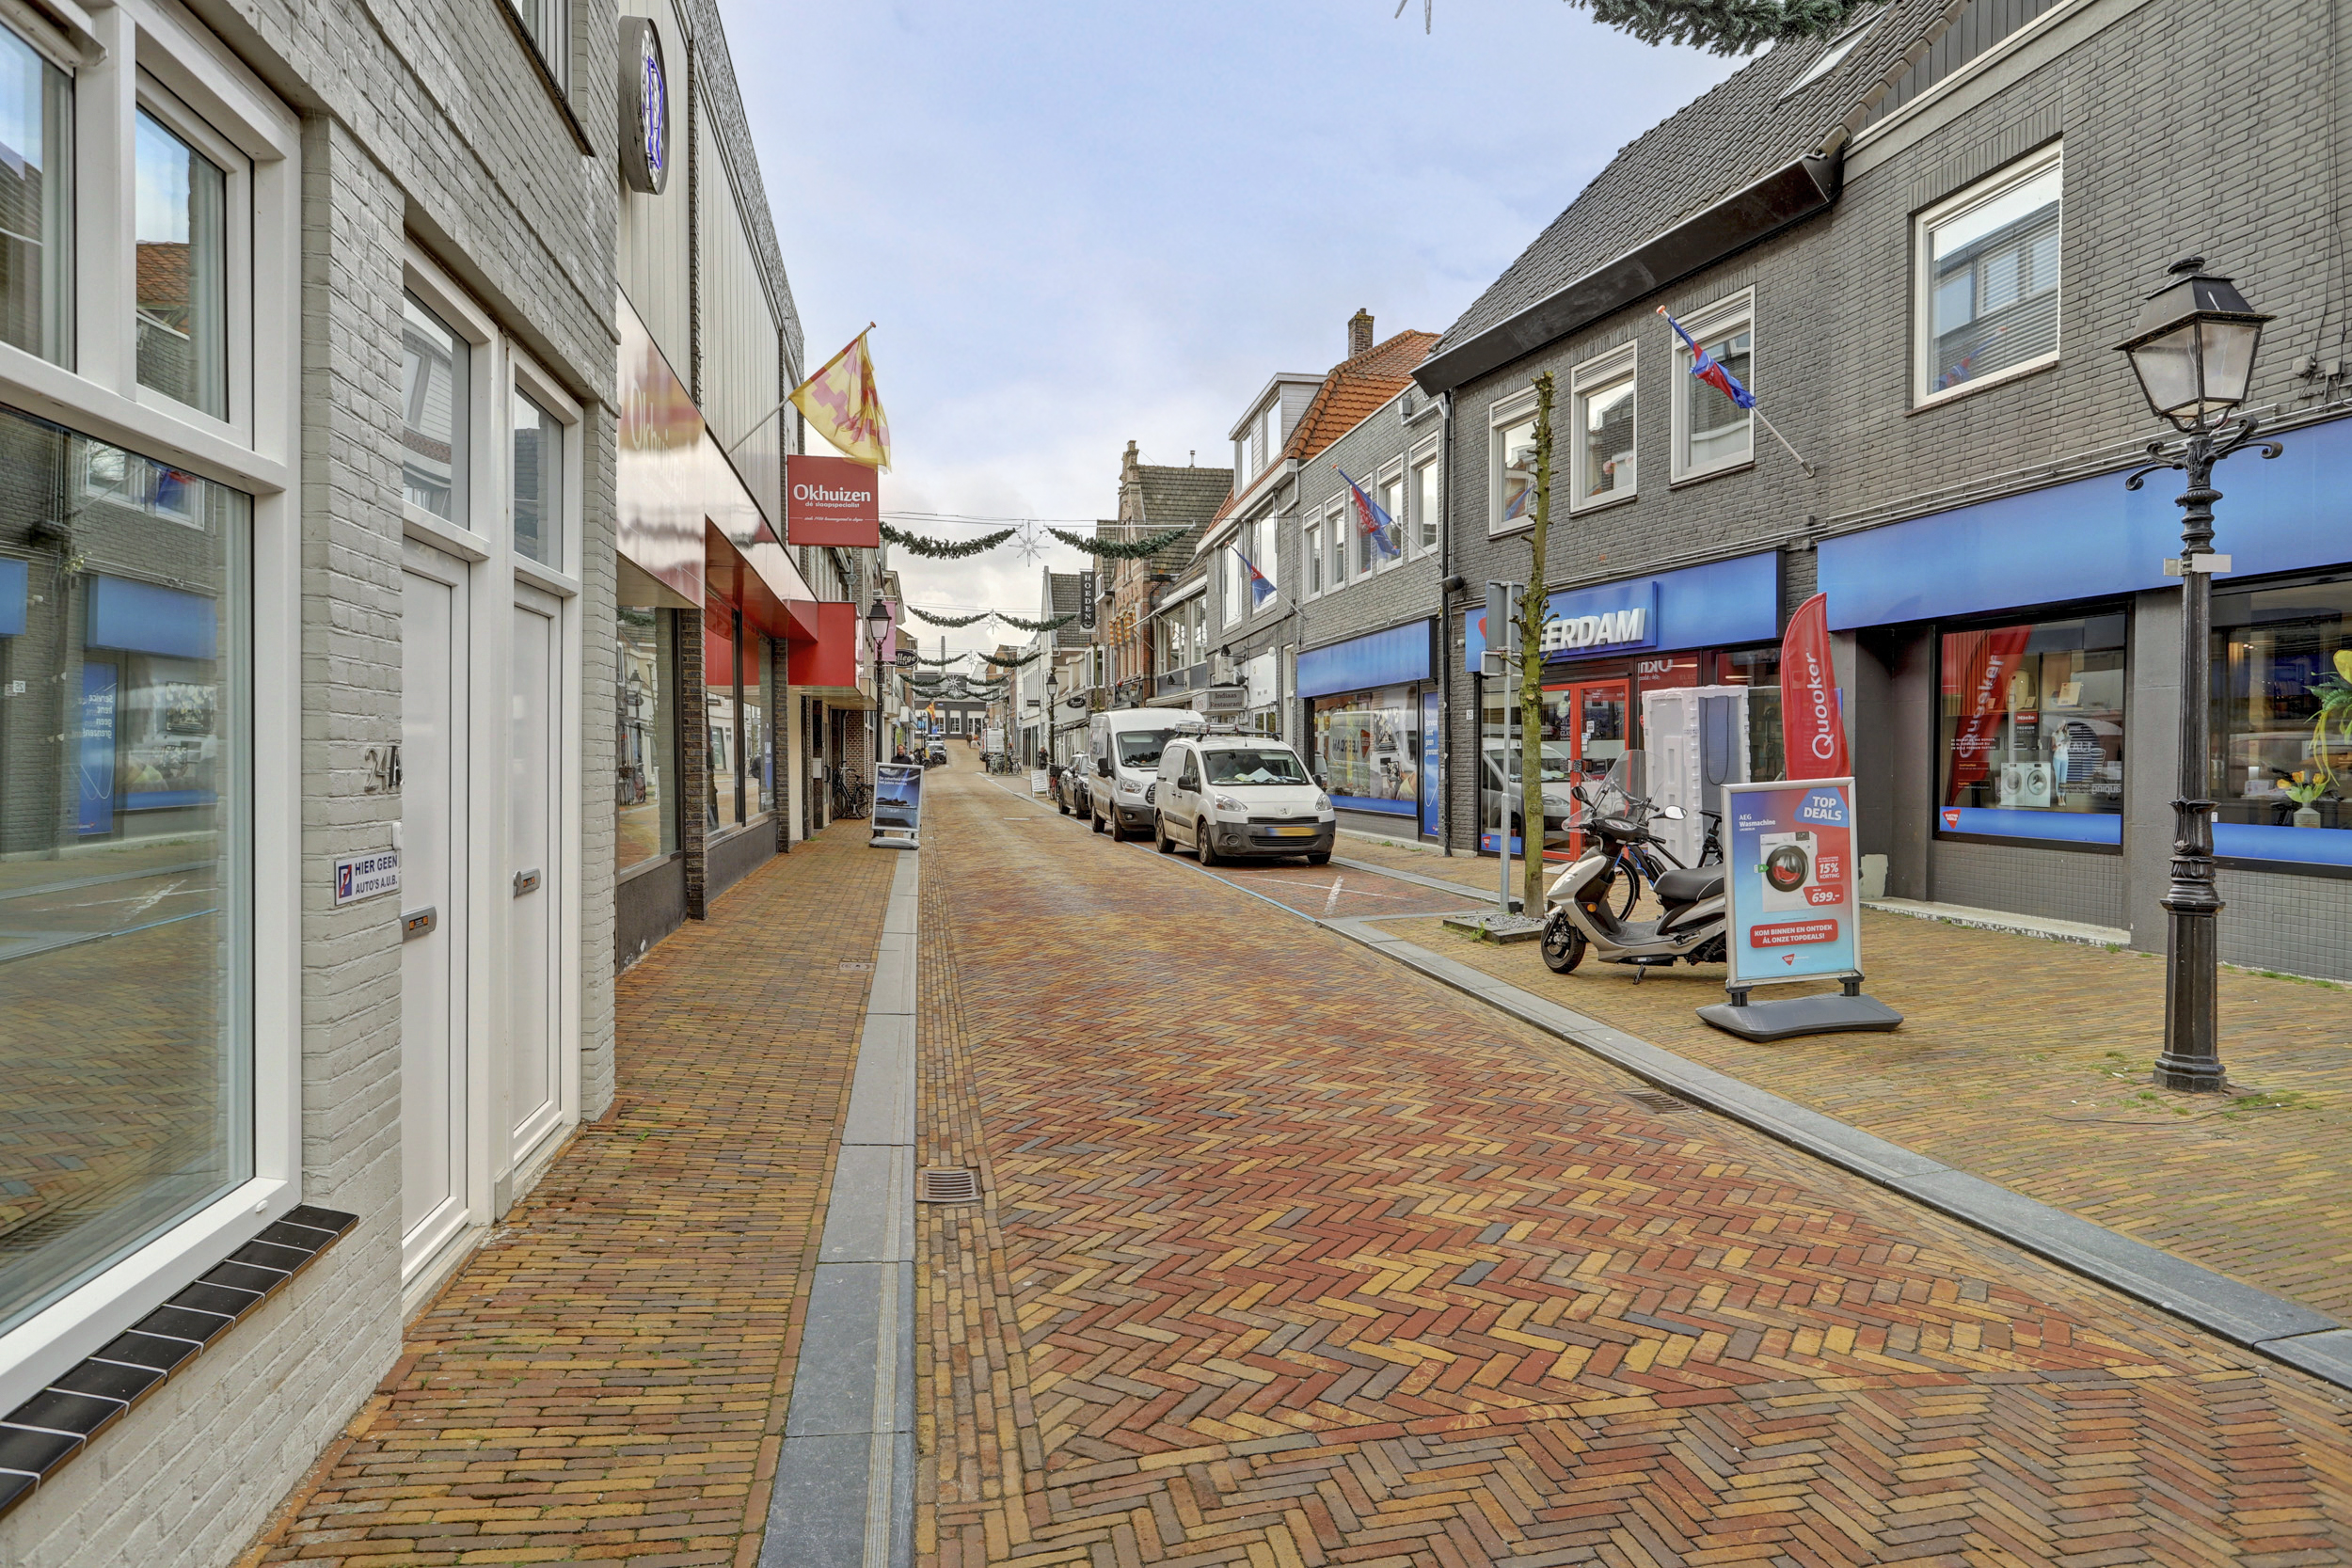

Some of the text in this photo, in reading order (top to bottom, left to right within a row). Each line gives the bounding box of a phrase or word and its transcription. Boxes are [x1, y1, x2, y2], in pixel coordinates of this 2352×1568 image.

[793, 483, 871, 502] Okhuizen
[1084, 574, 1092, 620] HOEDEN
[1807, 652, 1836, 760] Quooker
[1467, 710, 1473, 720] 25
[1812, 796, 1837, 808] TOP
[1804, 807, 1842, 821] DEALS
[1739, 819, 1776, 828] Wasmachine
[355, 855, 398, 877] HIER GEEN
[1820, 863, 1839, 874] 15%
[355, 875, 398, 895] AUTO'S A.U.B.
[1811, 891, 1840, 903] 699.-
[1790, 933, 1825, 942] TOPDEALS!
